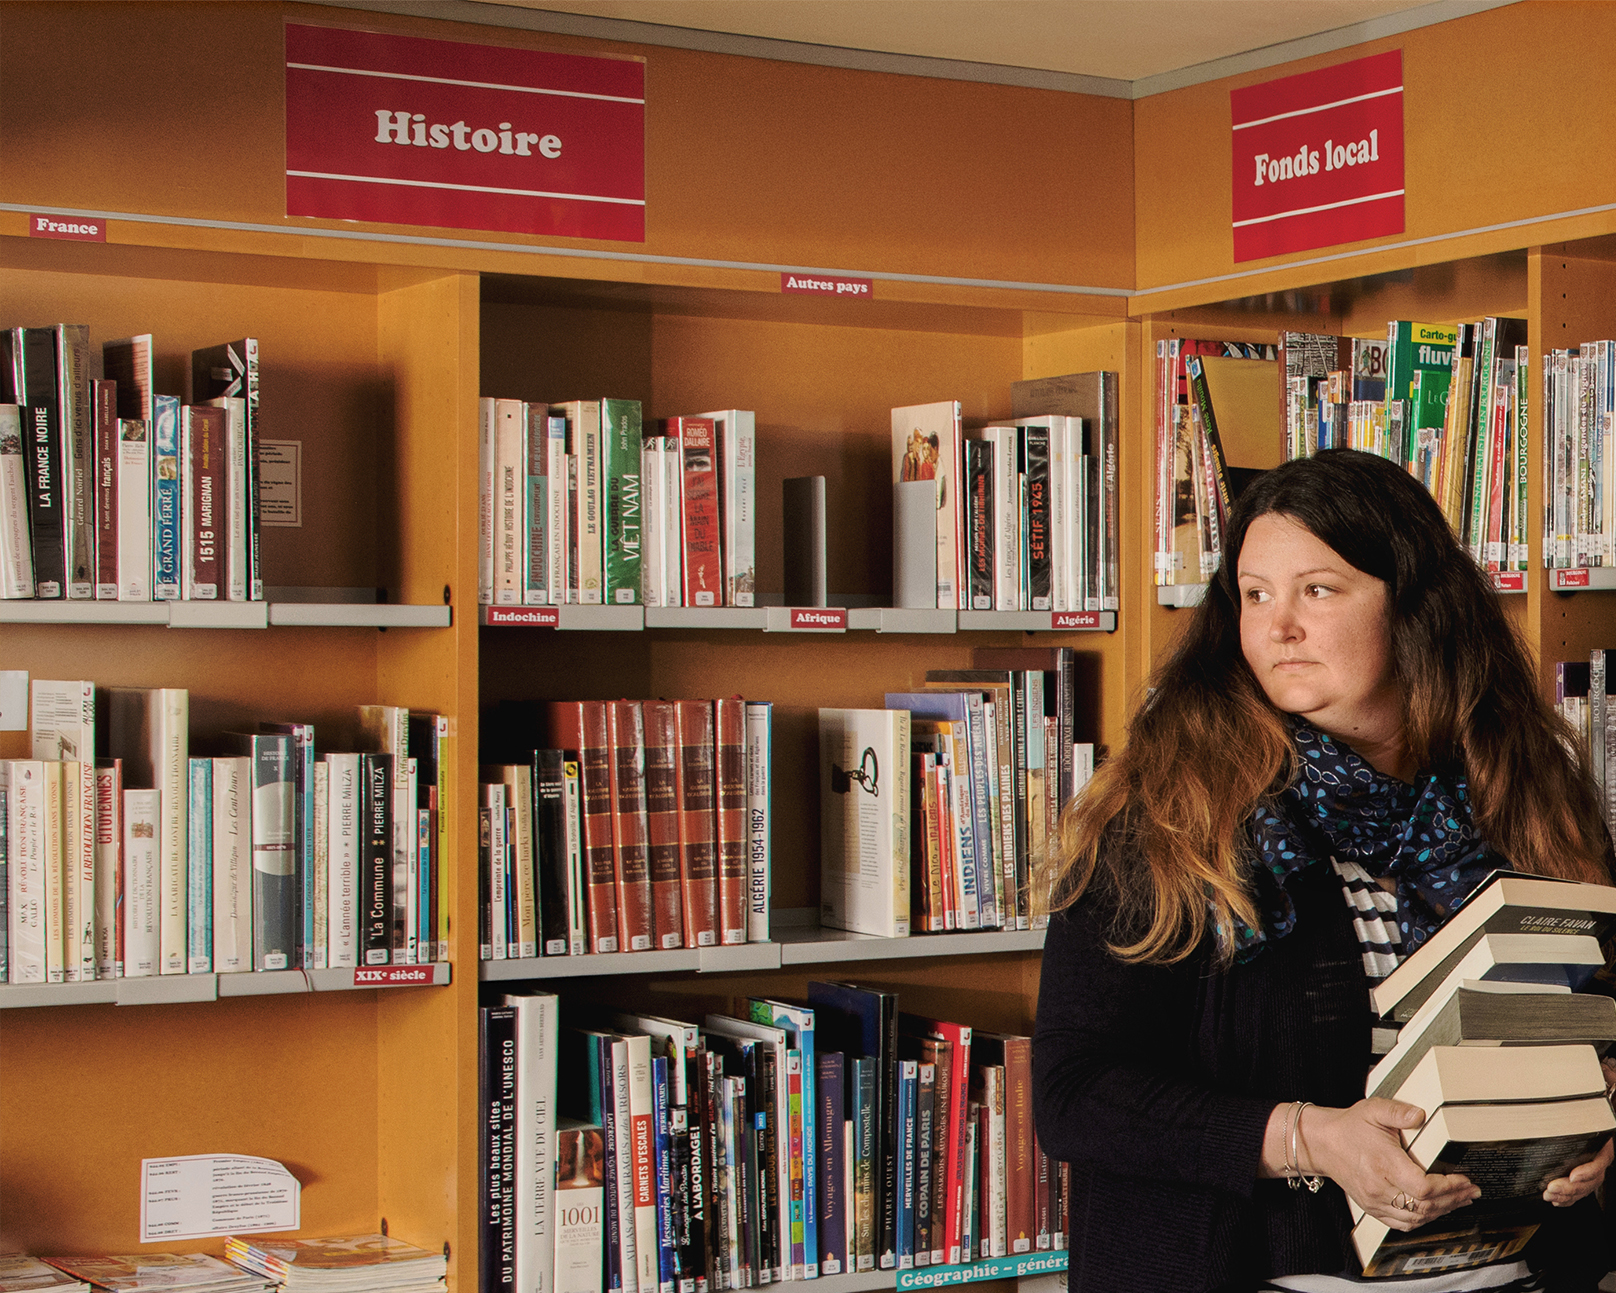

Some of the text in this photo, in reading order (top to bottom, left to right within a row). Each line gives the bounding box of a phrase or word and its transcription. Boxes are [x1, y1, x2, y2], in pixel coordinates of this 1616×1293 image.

[375, 109, 562, 159] Histoire
[1254, 128, 1379, 186] Fonds local
[36, 218, 98, 236] France
[786, 277, 867, 295] Autres pays
[36, 407, 51, 507] LA FRANCE NOIRE
[1520, 398, 1528, 483] BOURGOGNE
[200, 476, 214, 562] 1515 MARIGNAN
[620, 474, 639, 561] VIÊT NAM
[1032, 483, 1044, 559] SÉTIF 1945
[492, 610, 556, 624] Indochine
[796, 611, 840, 624] Afrique
[1057, 614, 1094, 627] Algérie
[750, 809, 765, 913] ALGÉRIE 1954-1962
[1520, 915, 1597, 930] CLAIRE FAVAN
[389, 968, 426, 982] siècle
[489, 1101, 501, 1224] Les plus beaux sites
[503, 1040, 513, 1282] DU PATRIMOINE MONDIAL DE L'UNESCO
[637, 1120, 649, 1201] CARNETS D'ESCALES
[900, 1255, 1068, 1291] Géographie généra
